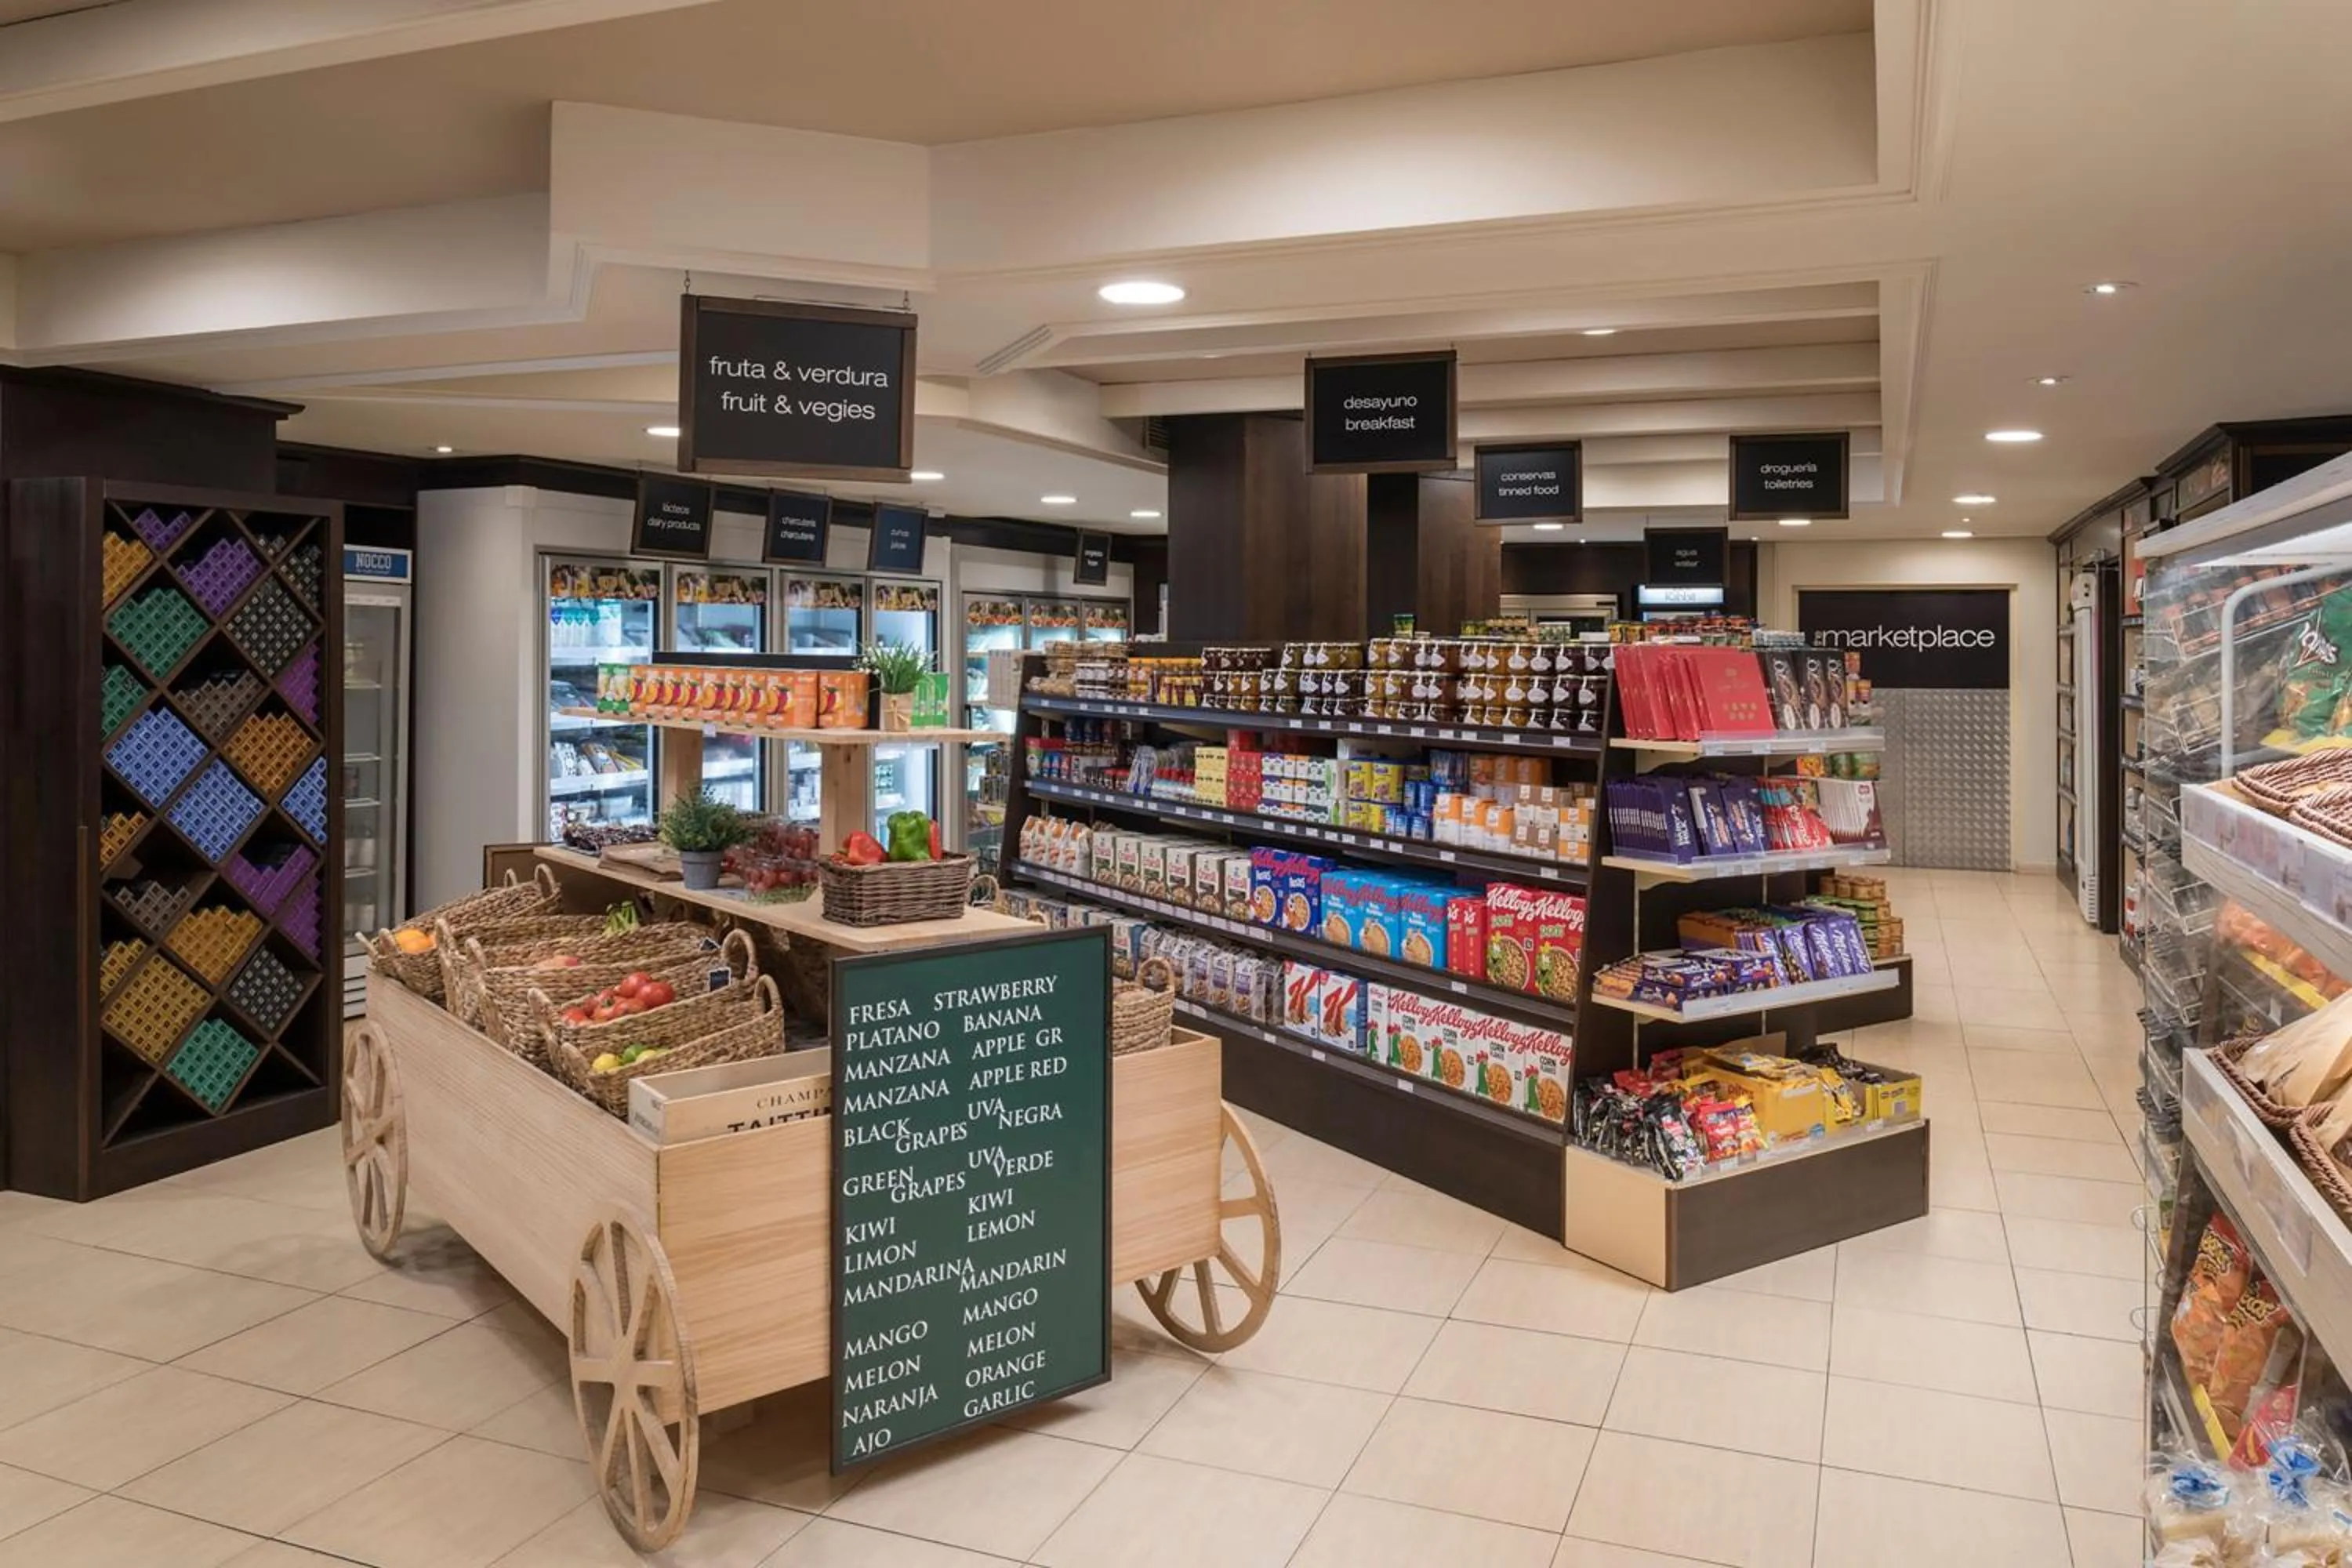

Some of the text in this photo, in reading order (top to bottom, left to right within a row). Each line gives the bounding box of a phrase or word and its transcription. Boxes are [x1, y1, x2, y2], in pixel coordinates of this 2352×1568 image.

[709, 355, 888, 389] fruta & verdura
[721, 391, 876, 423] fruit & vegies
[1343, 395, 1417, 411] desayuno
[1345, 416, 1415, 430] breakfast
[1498, 484, 1559, 496] tinned food
[1500, 471, 1556, 482] conservas
[1764, 479, 1813, 490] toiletries
[1823, 625, 1995, 652] marketplace
[849, 975, 1058, 1025] FRESA STRAWBERRY
[846, 1004, 1043, 1051] PLATANO BANANA
[844, 1027, 1064, 1083] MANZANA APPLE GR
[844, 1056, 1068, 1116] MANZANA APPLE RED
[967, 1098, 1064, 1130] UVA NEGRA
[844, 1117, 967, 1154] BLACK GRAPES
[968, 1145, 1054, 1178] UVA VERDE
[843, 1166, 966, 1204] GREEN GRAPES
[844, 1188, 1014, 1245] KIWI KIWI
[844, 1210, 1036, 1274] LIMON LEMON
[843, 1248, 1067, 1307] MANDARINA MANDARIN
[844, 1287, 1039, 1360] MANGO MANGO
[844, 1322, 1036, 1394] MELON MELON
[842, 1350, 1047, 1428] NARANJA ORANGE
[852, 1381, 1036, 1457] AJO GARLIC
